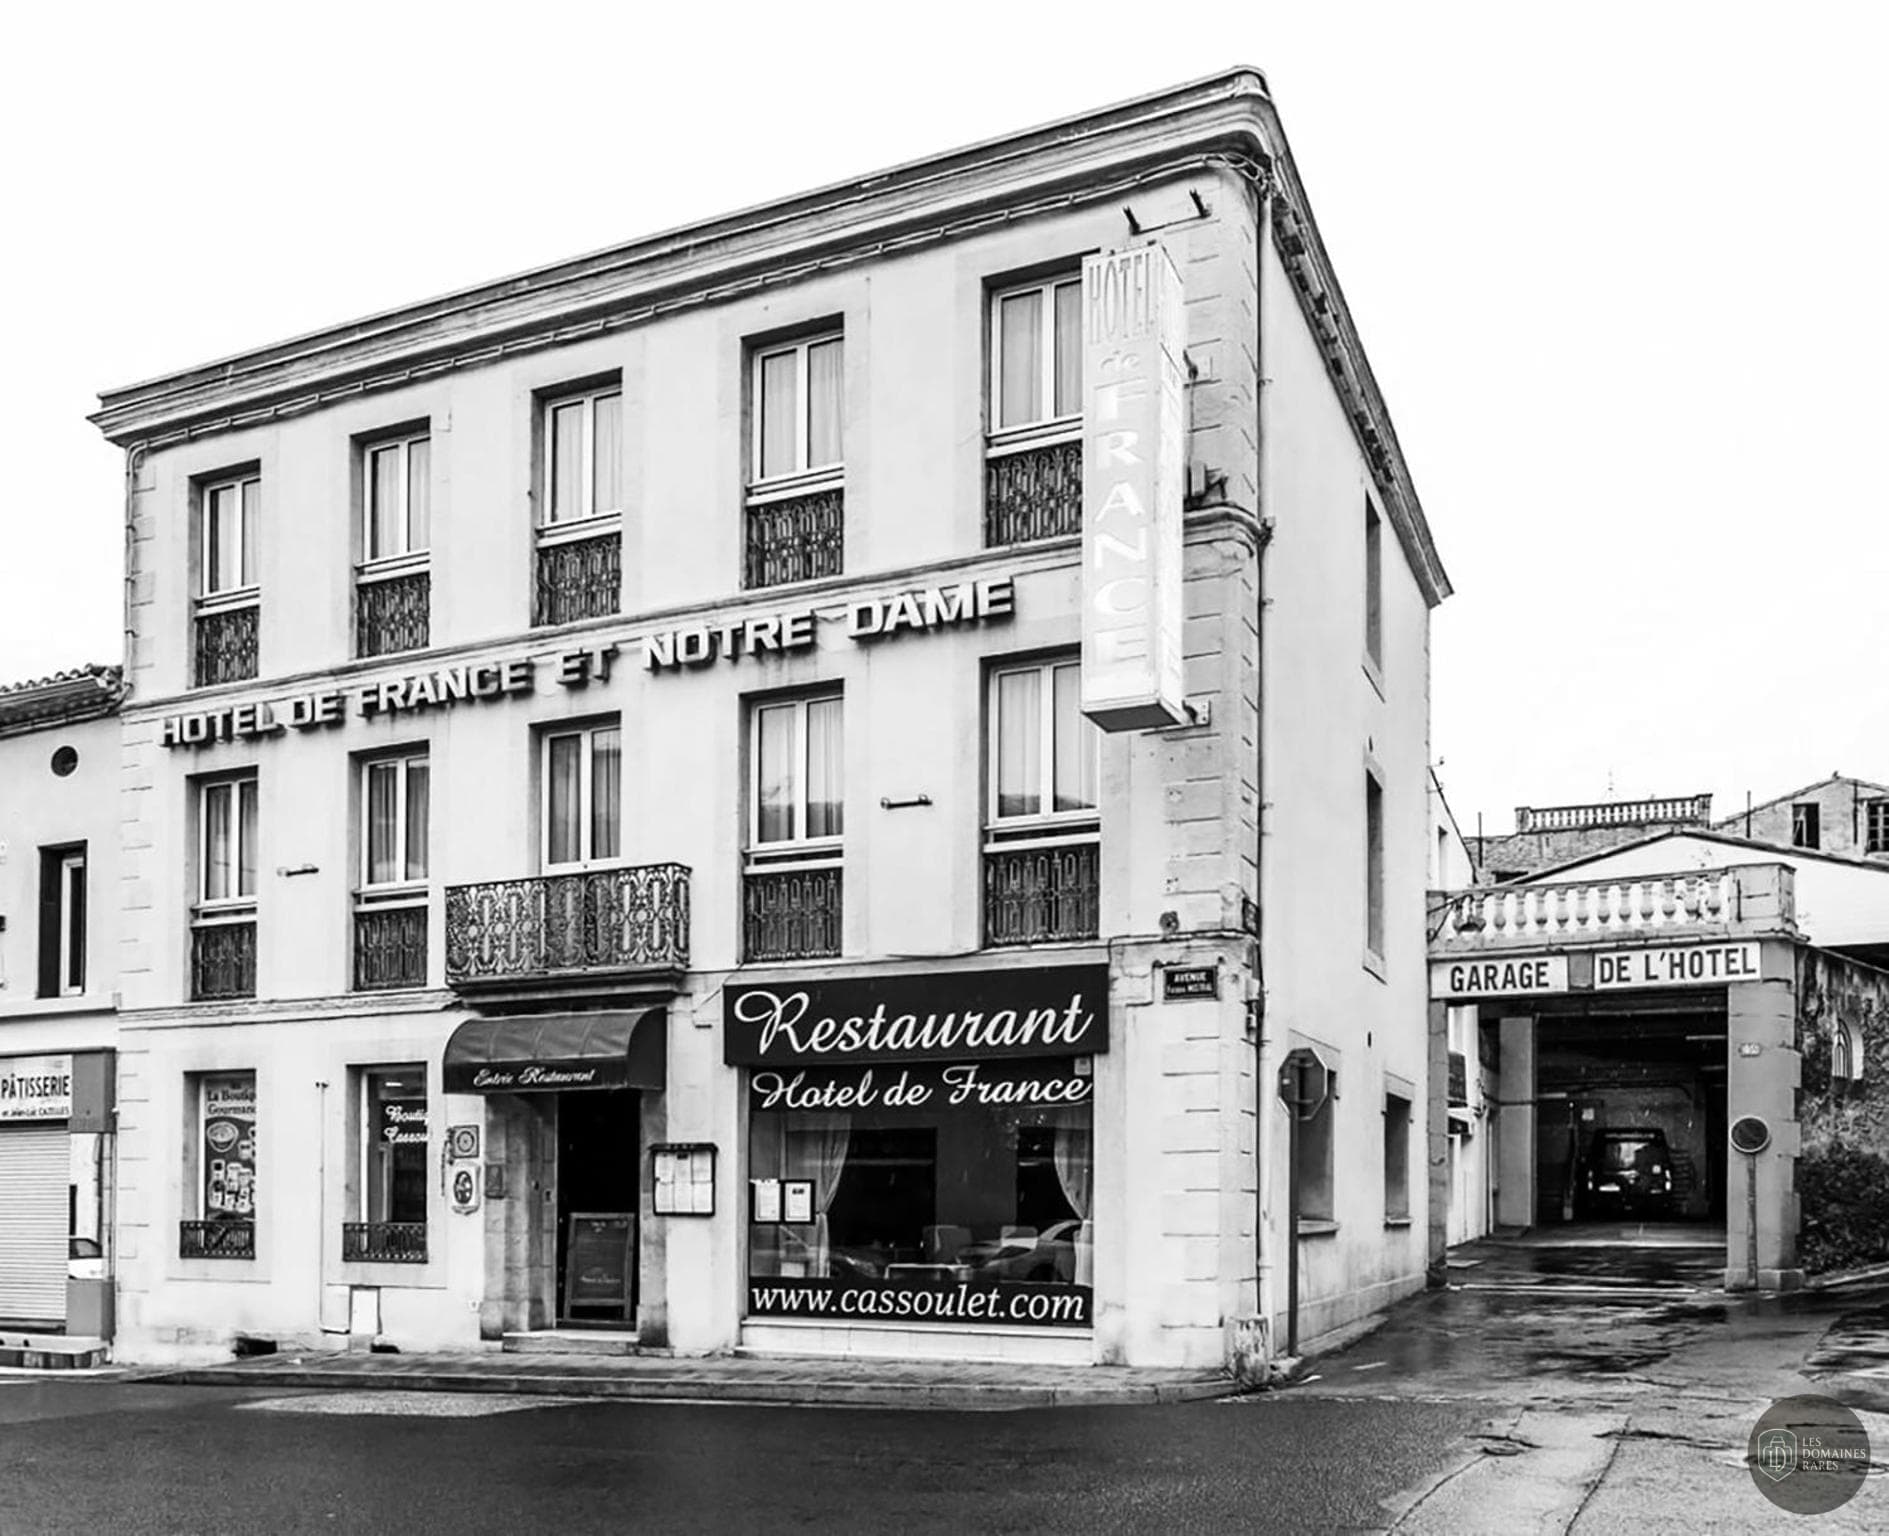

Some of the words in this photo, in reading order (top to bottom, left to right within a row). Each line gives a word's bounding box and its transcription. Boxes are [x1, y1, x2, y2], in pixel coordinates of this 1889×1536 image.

[1088, 252, 1155, 345] HOTEL
[1093, 377, 1149, 668] FRANCE
[161, 701, 283, 747] HOTEL
[289, 692, 345, 729] DE
[355, 658, 534, 717] FRANCE
[556, 641, 616, 685] ET
[641, 610, 818, 671] NOTRE
[848, 576, 1016, 641] DAME
[1450, 961, 1550, 992] GARAGE
[1599, 955, 1631, 983] DE
[1645, 947, 1757, 981] L'HOTEL
[734, 990, 1095, 1056] Restaurant
[1, 1072, 70, 1099] PÂTISSERIE
[518, 1066, 597, 1085] Restaurant
[751, 1069, 878, 1109] Hotel
[883, 1070, 934, 1106] de
[941, 1064, 1094, 1105] France
[752, 1284, 1085, 1320] www.cassoulet.com
